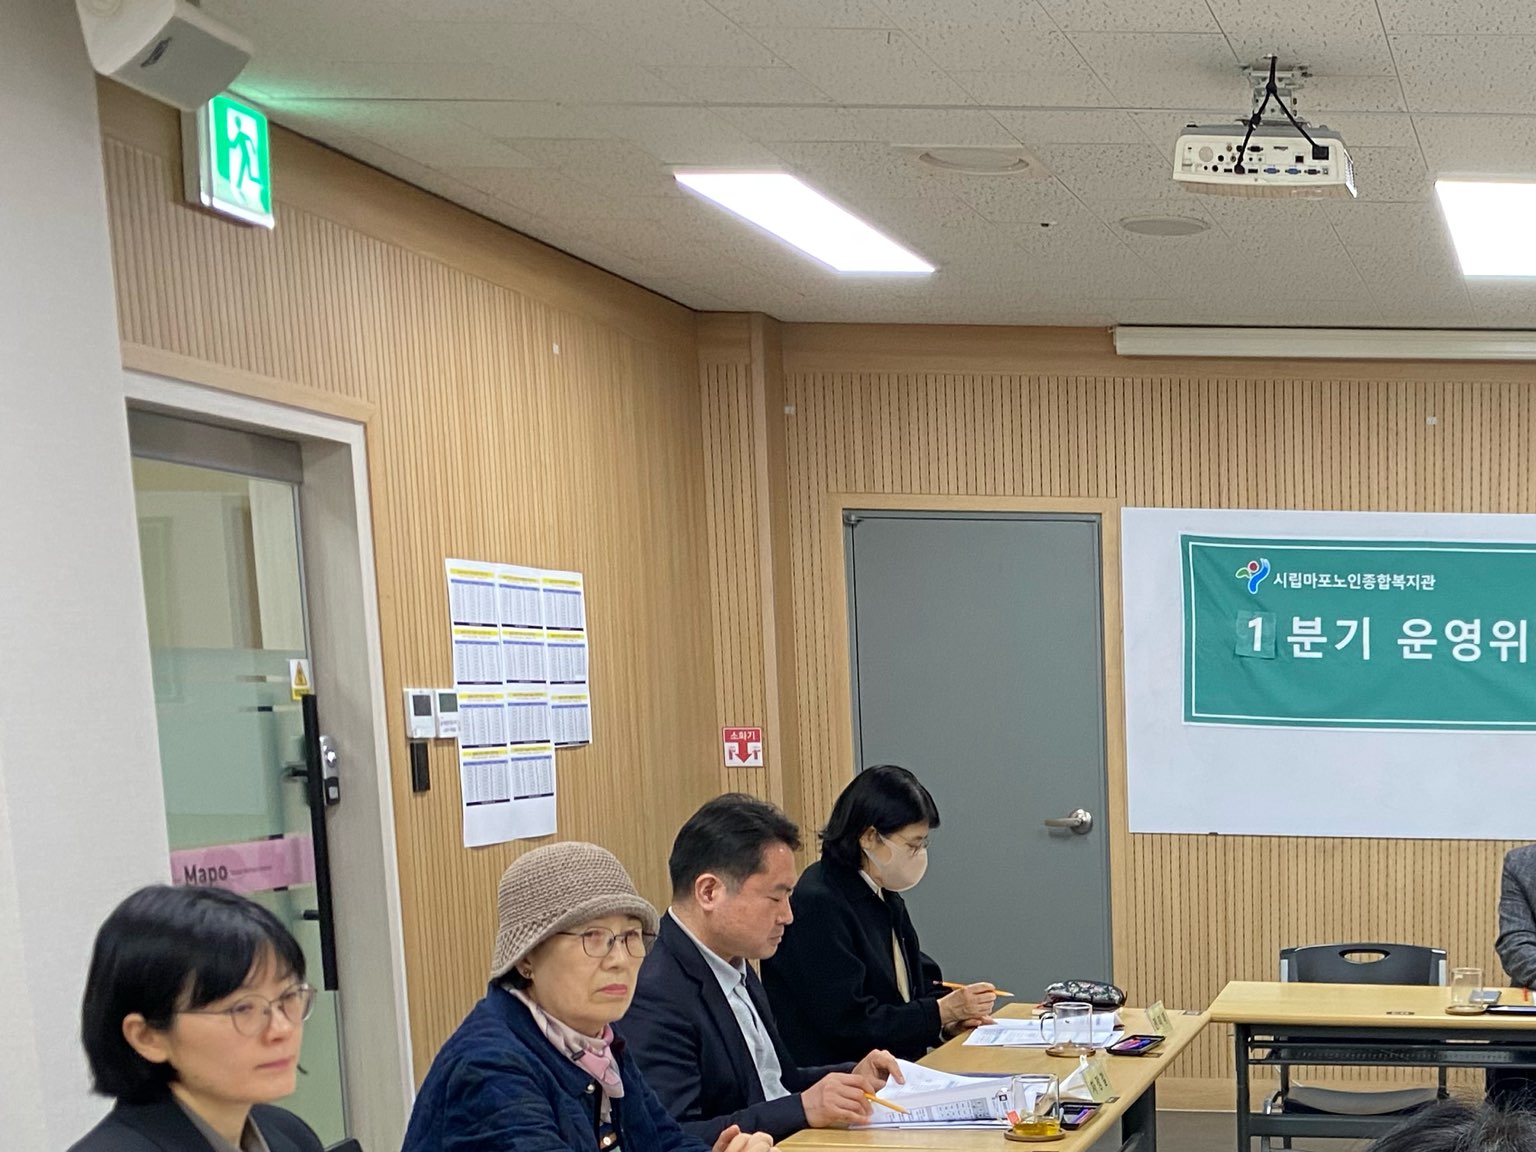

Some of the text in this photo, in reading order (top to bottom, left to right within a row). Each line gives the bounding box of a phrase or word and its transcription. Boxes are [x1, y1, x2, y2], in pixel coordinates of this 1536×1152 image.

[1273, 571, 1437, 592] 시립마포노인종합복지관
[730, 731, 756, 741] 소화기
[183, 864, 229, 888] Mapo
